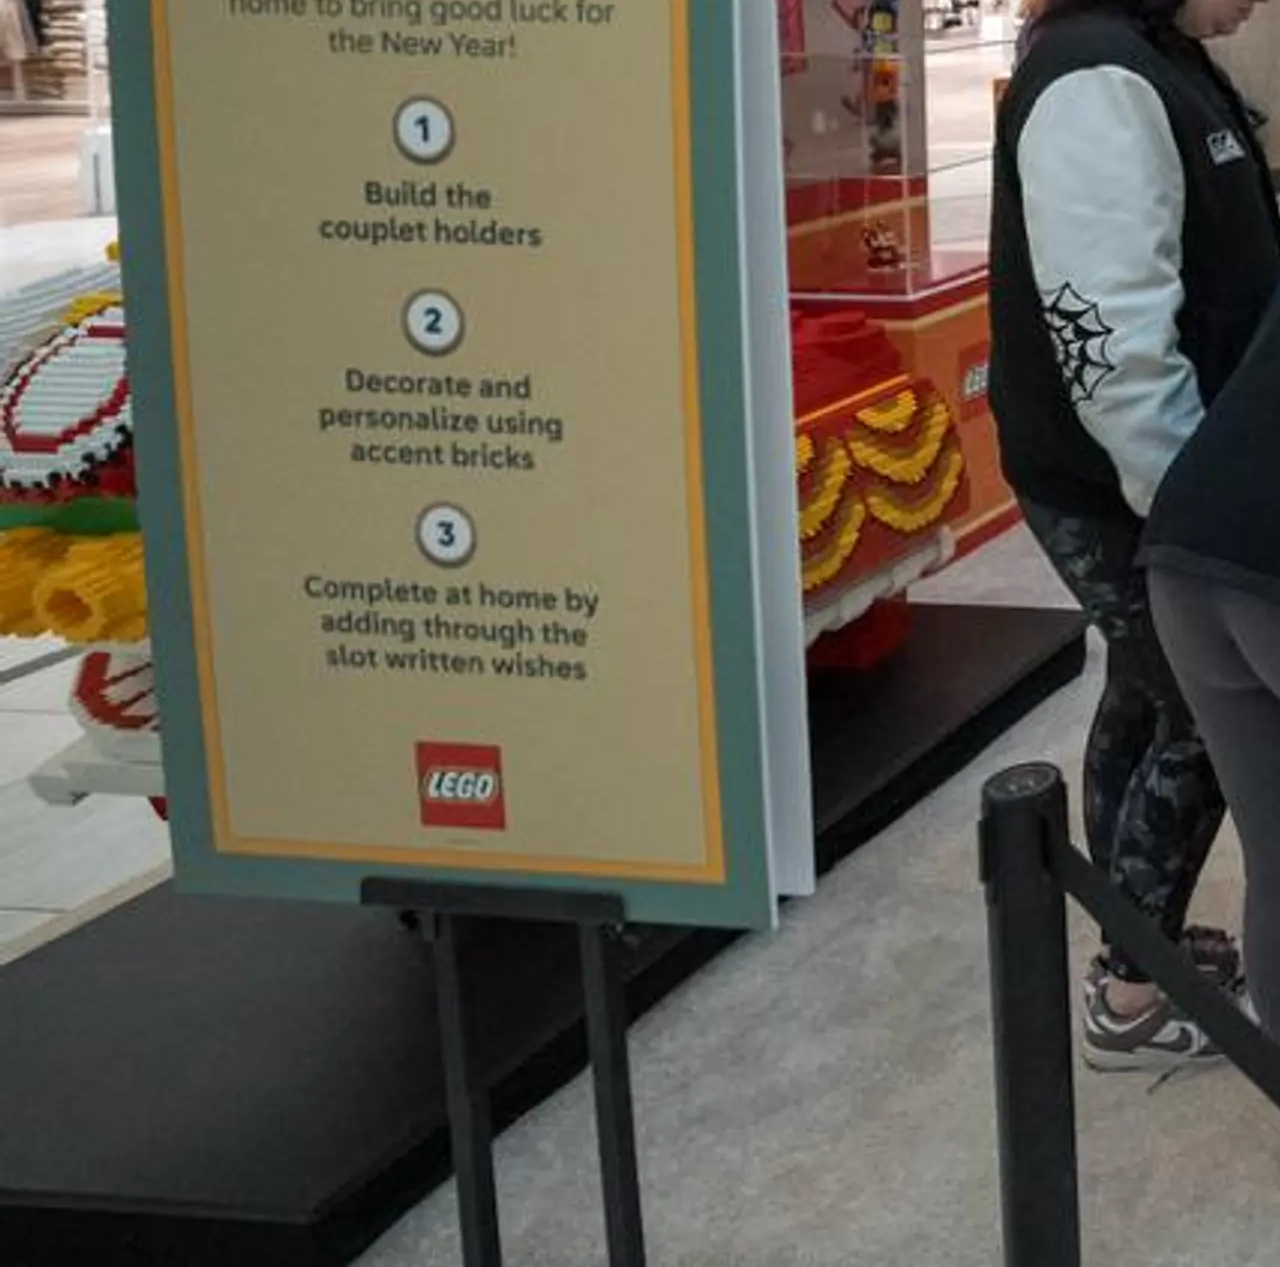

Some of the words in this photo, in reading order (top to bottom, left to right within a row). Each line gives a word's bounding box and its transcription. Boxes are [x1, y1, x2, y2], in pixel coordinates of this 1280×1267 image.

[328, 28, 373, 54] the
[381, 31, 442, 56] New
[447, 32, 518, 60] Year!
[415, 116, 429, 142] 1
[365, 181, 436, 207] Build
[445, 183, 491, 209] the
[319, 216, 426, 245] couplet
[434, 217, 542, 247] holders
[425, 308, 441, 334] 2
[346, 368, 472, 398] Decorate
[479, 376, 531, 400] and
[319, 406, 478, 433] personalize
[487, 410, 563, 442] using
[351, 444, 444, 465] accent
[451, 442, 535, 470] bricks
[438, 521, 455, 547] 3
[304, 576, 438, 607] Complete
[446, 586, 471, 605] at
[479, 582, 557, 610] home
[565, 587, 599, 619] by
[321, 611, 415, 643] adding
[423, 614, 534, 649] through
[542, 621, 587, 646] the
[326, 644, 377, 668] slot
[385, 648, 484, 674] written
[492, 652, 587, 680] wishes
[426, 770, 495, 801] LEGO
